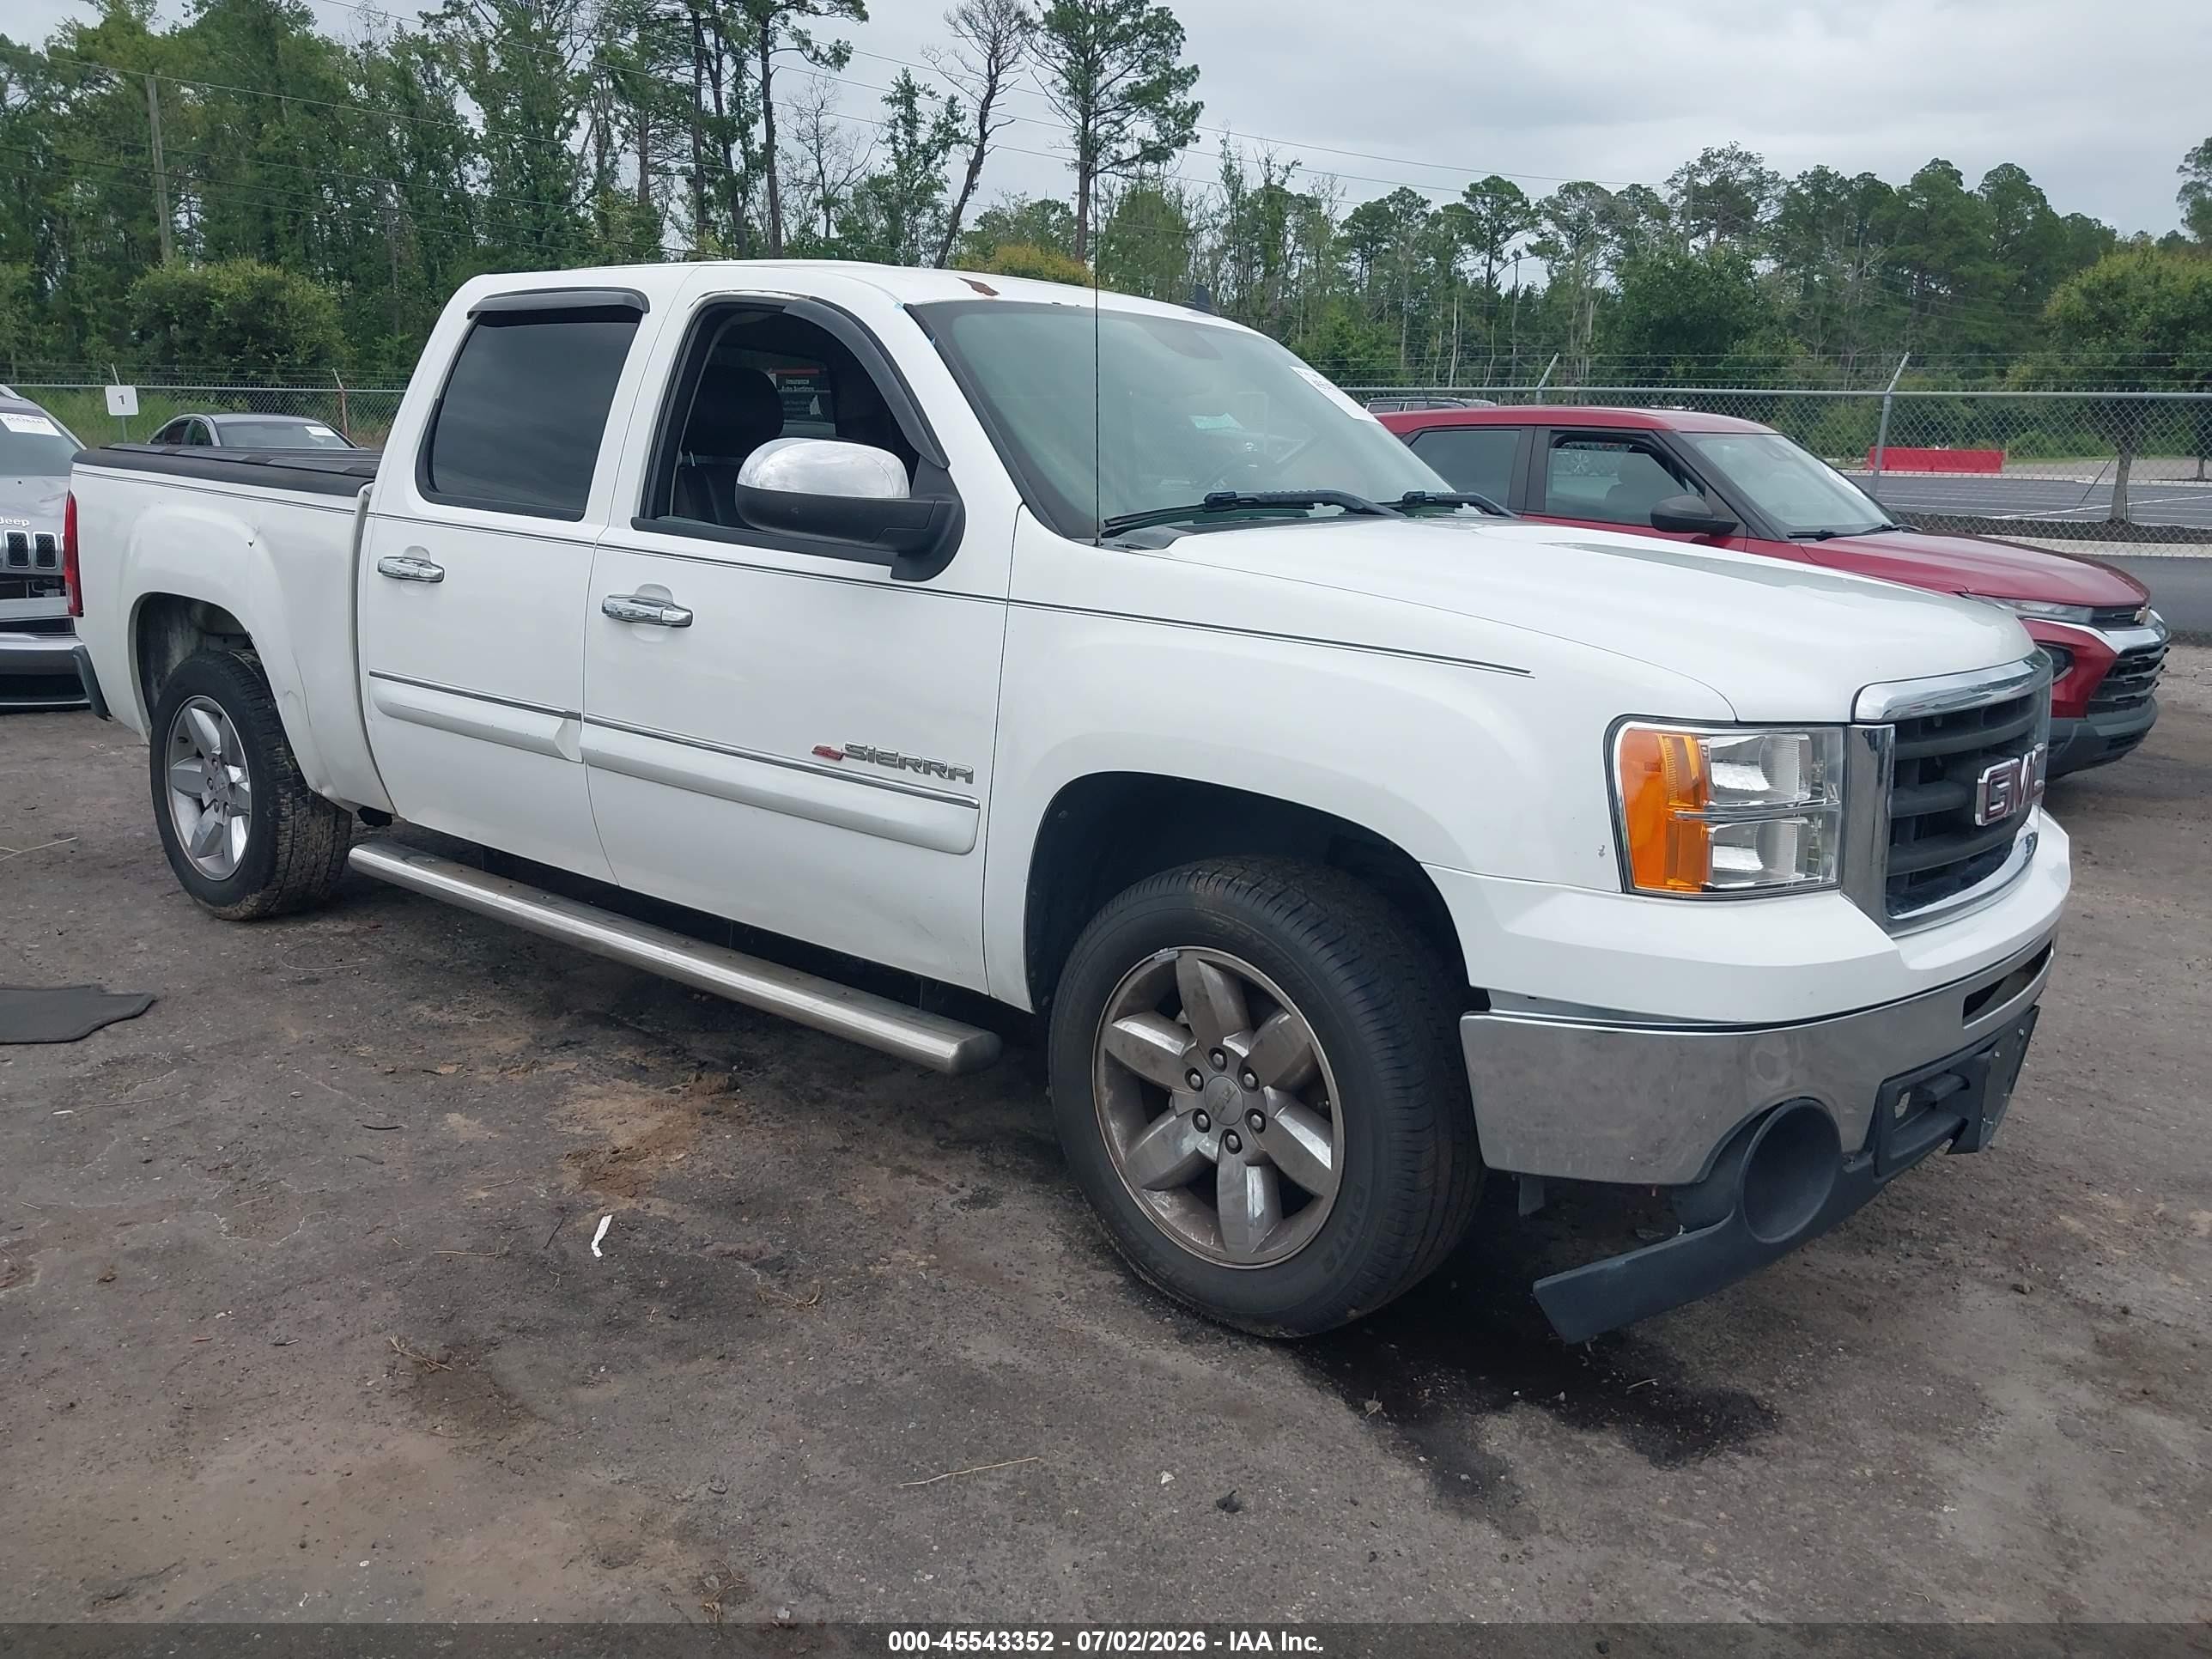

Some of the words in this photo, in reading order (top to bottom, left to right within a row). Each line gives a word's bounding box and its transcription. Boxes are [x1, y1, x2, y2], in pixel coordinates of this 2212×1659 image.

[118, 394, 125, 405] 1
[0, 516, 30, 528] Jeep
[844, 740, 975, 785] SIERRA
